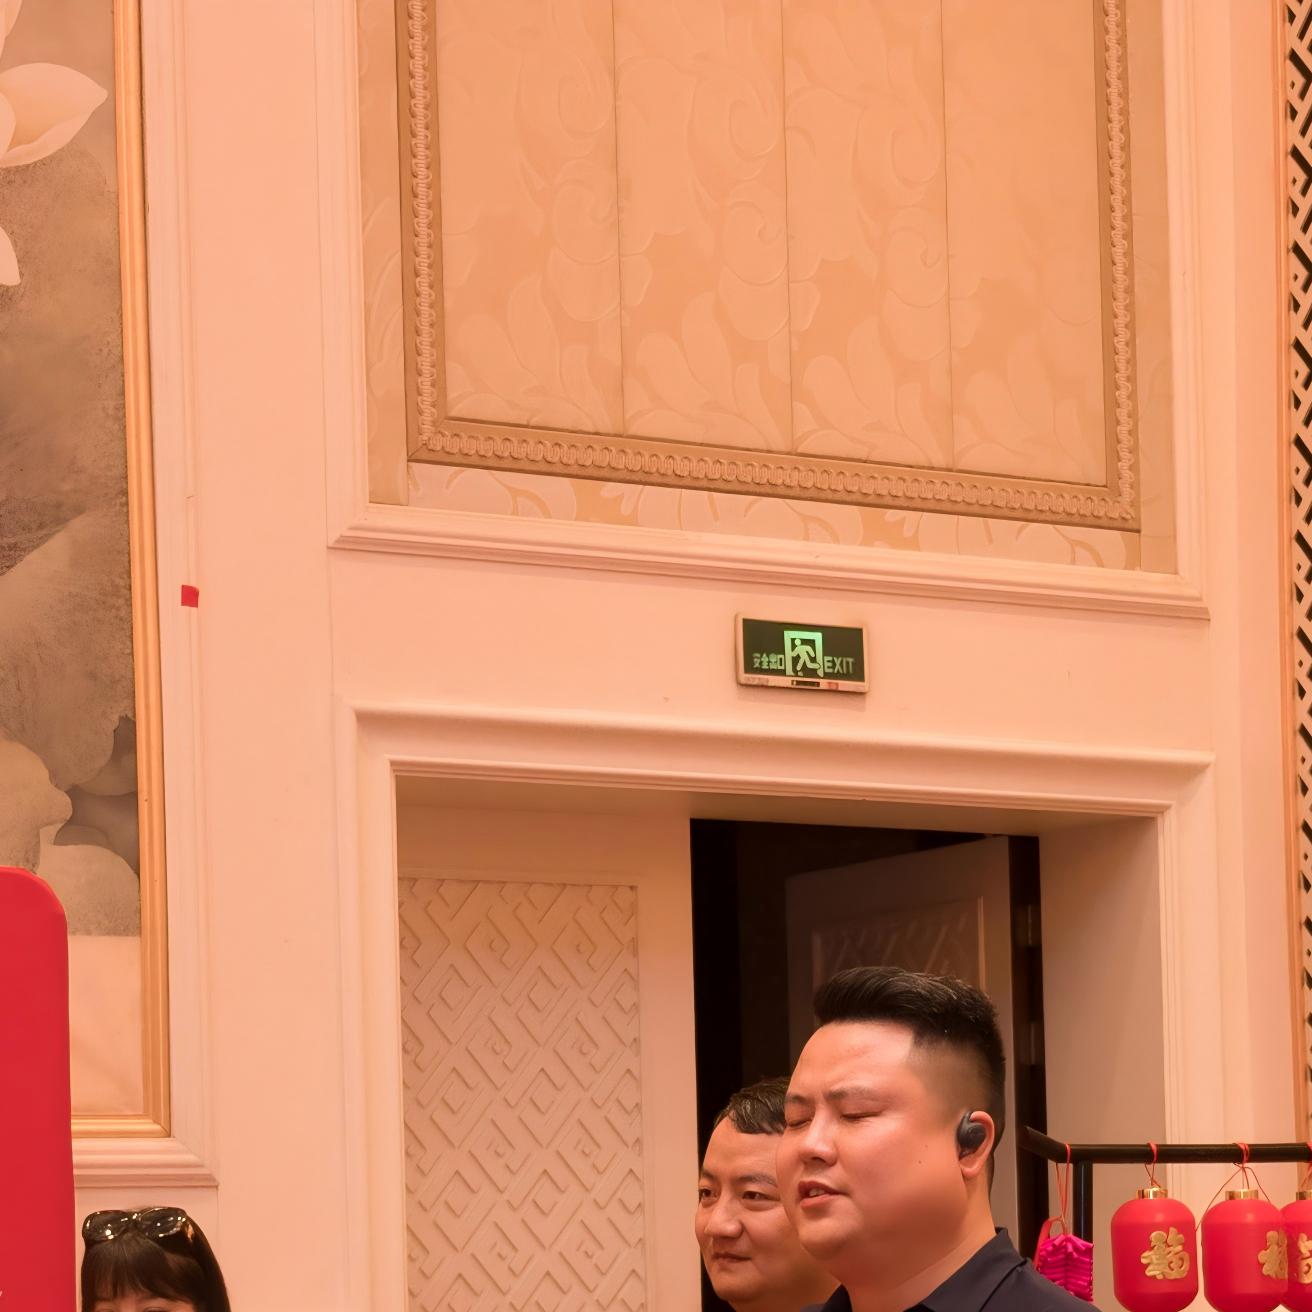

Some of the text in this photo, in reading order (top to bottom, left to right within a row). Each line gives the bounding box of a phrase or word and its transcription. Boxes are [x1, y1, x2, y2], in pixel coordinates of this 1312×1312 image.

[752, 652, 785, 670] 安全出口
[824, 655, 855, 675] EXIT
[1140, 1226, 1190, 1281] 福
